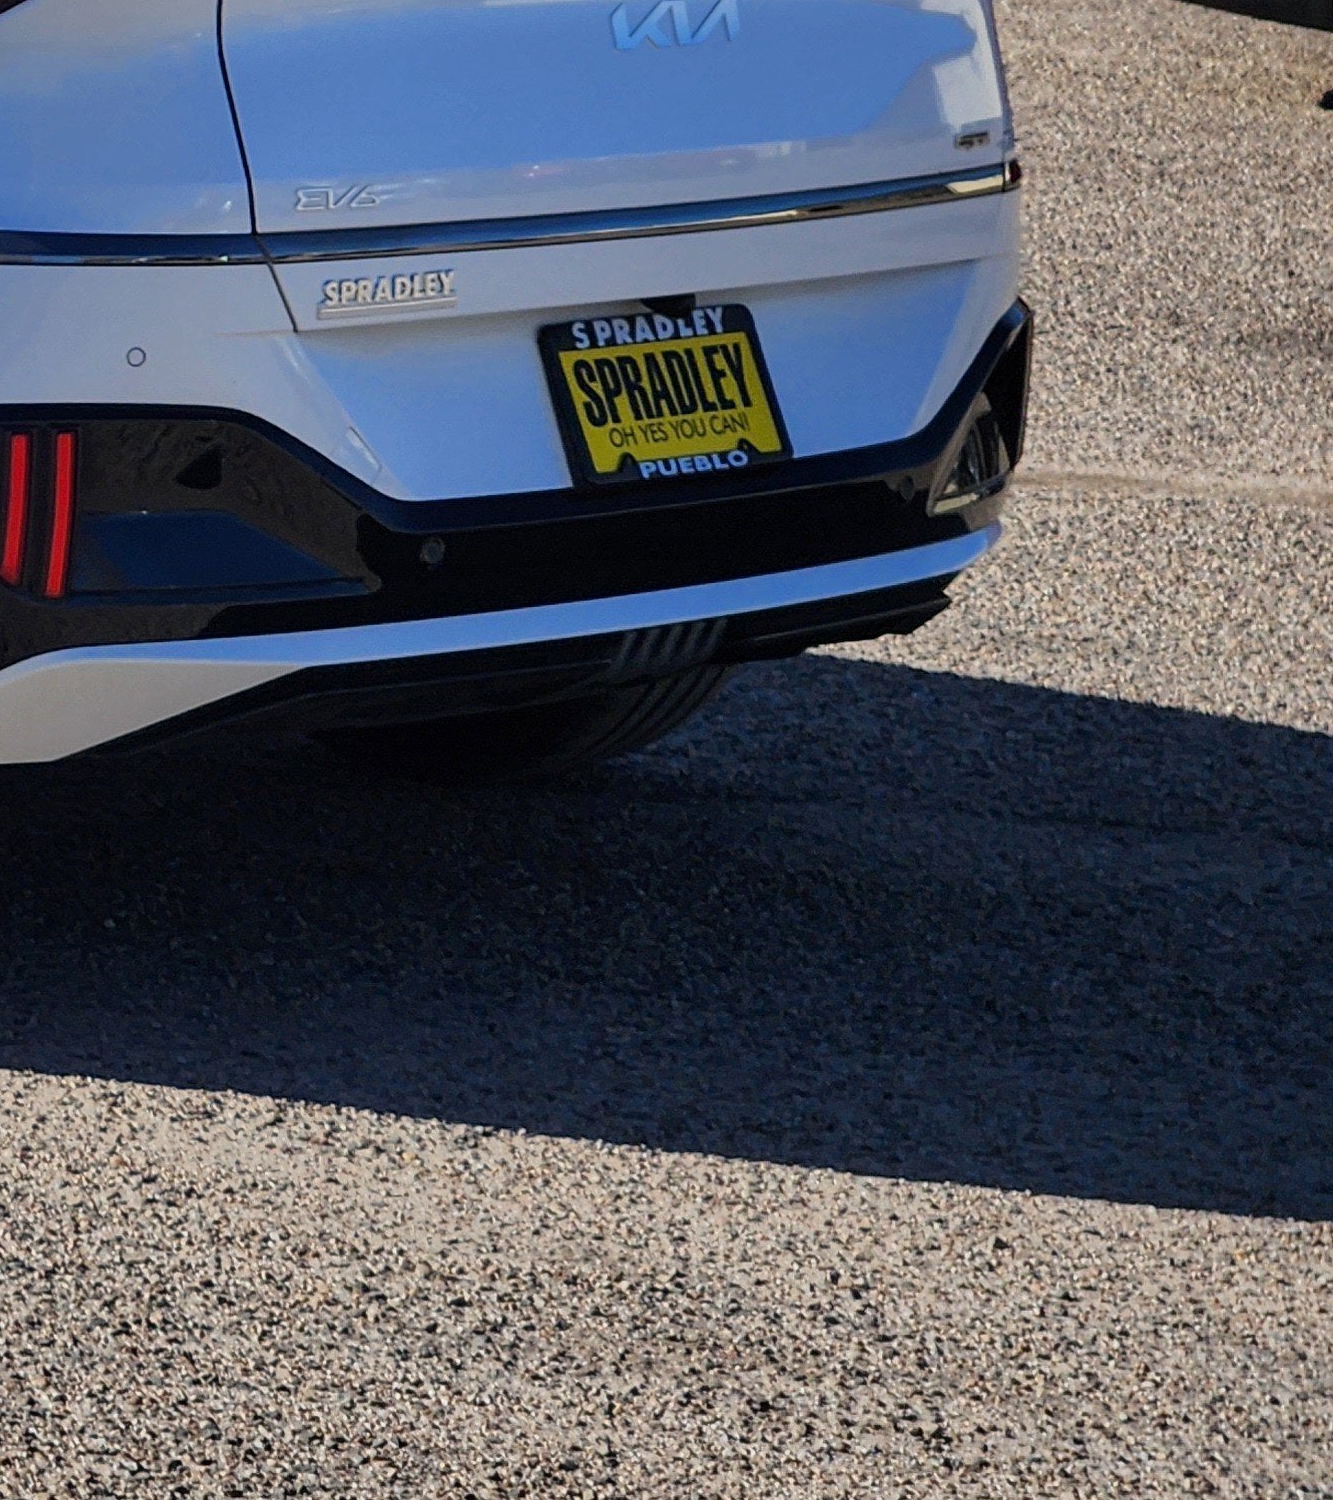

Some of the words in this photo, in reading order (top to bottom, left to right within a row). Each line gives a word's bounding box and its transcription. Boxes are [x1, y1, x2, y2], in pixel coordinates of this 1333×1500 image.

[295, 184, 382, 212] EV6
[323, 269, 455, 308] SPRADLEY
[573, 342, 754, 428] SPRADLEY
[608, 427, 638, 449] OH
[637, 421, 669, 445] YES
[667, 417, 708, 440] YOU
[709, 412, 751, 434] CAN!
[639, 449, 750, 479] PUEBLO
